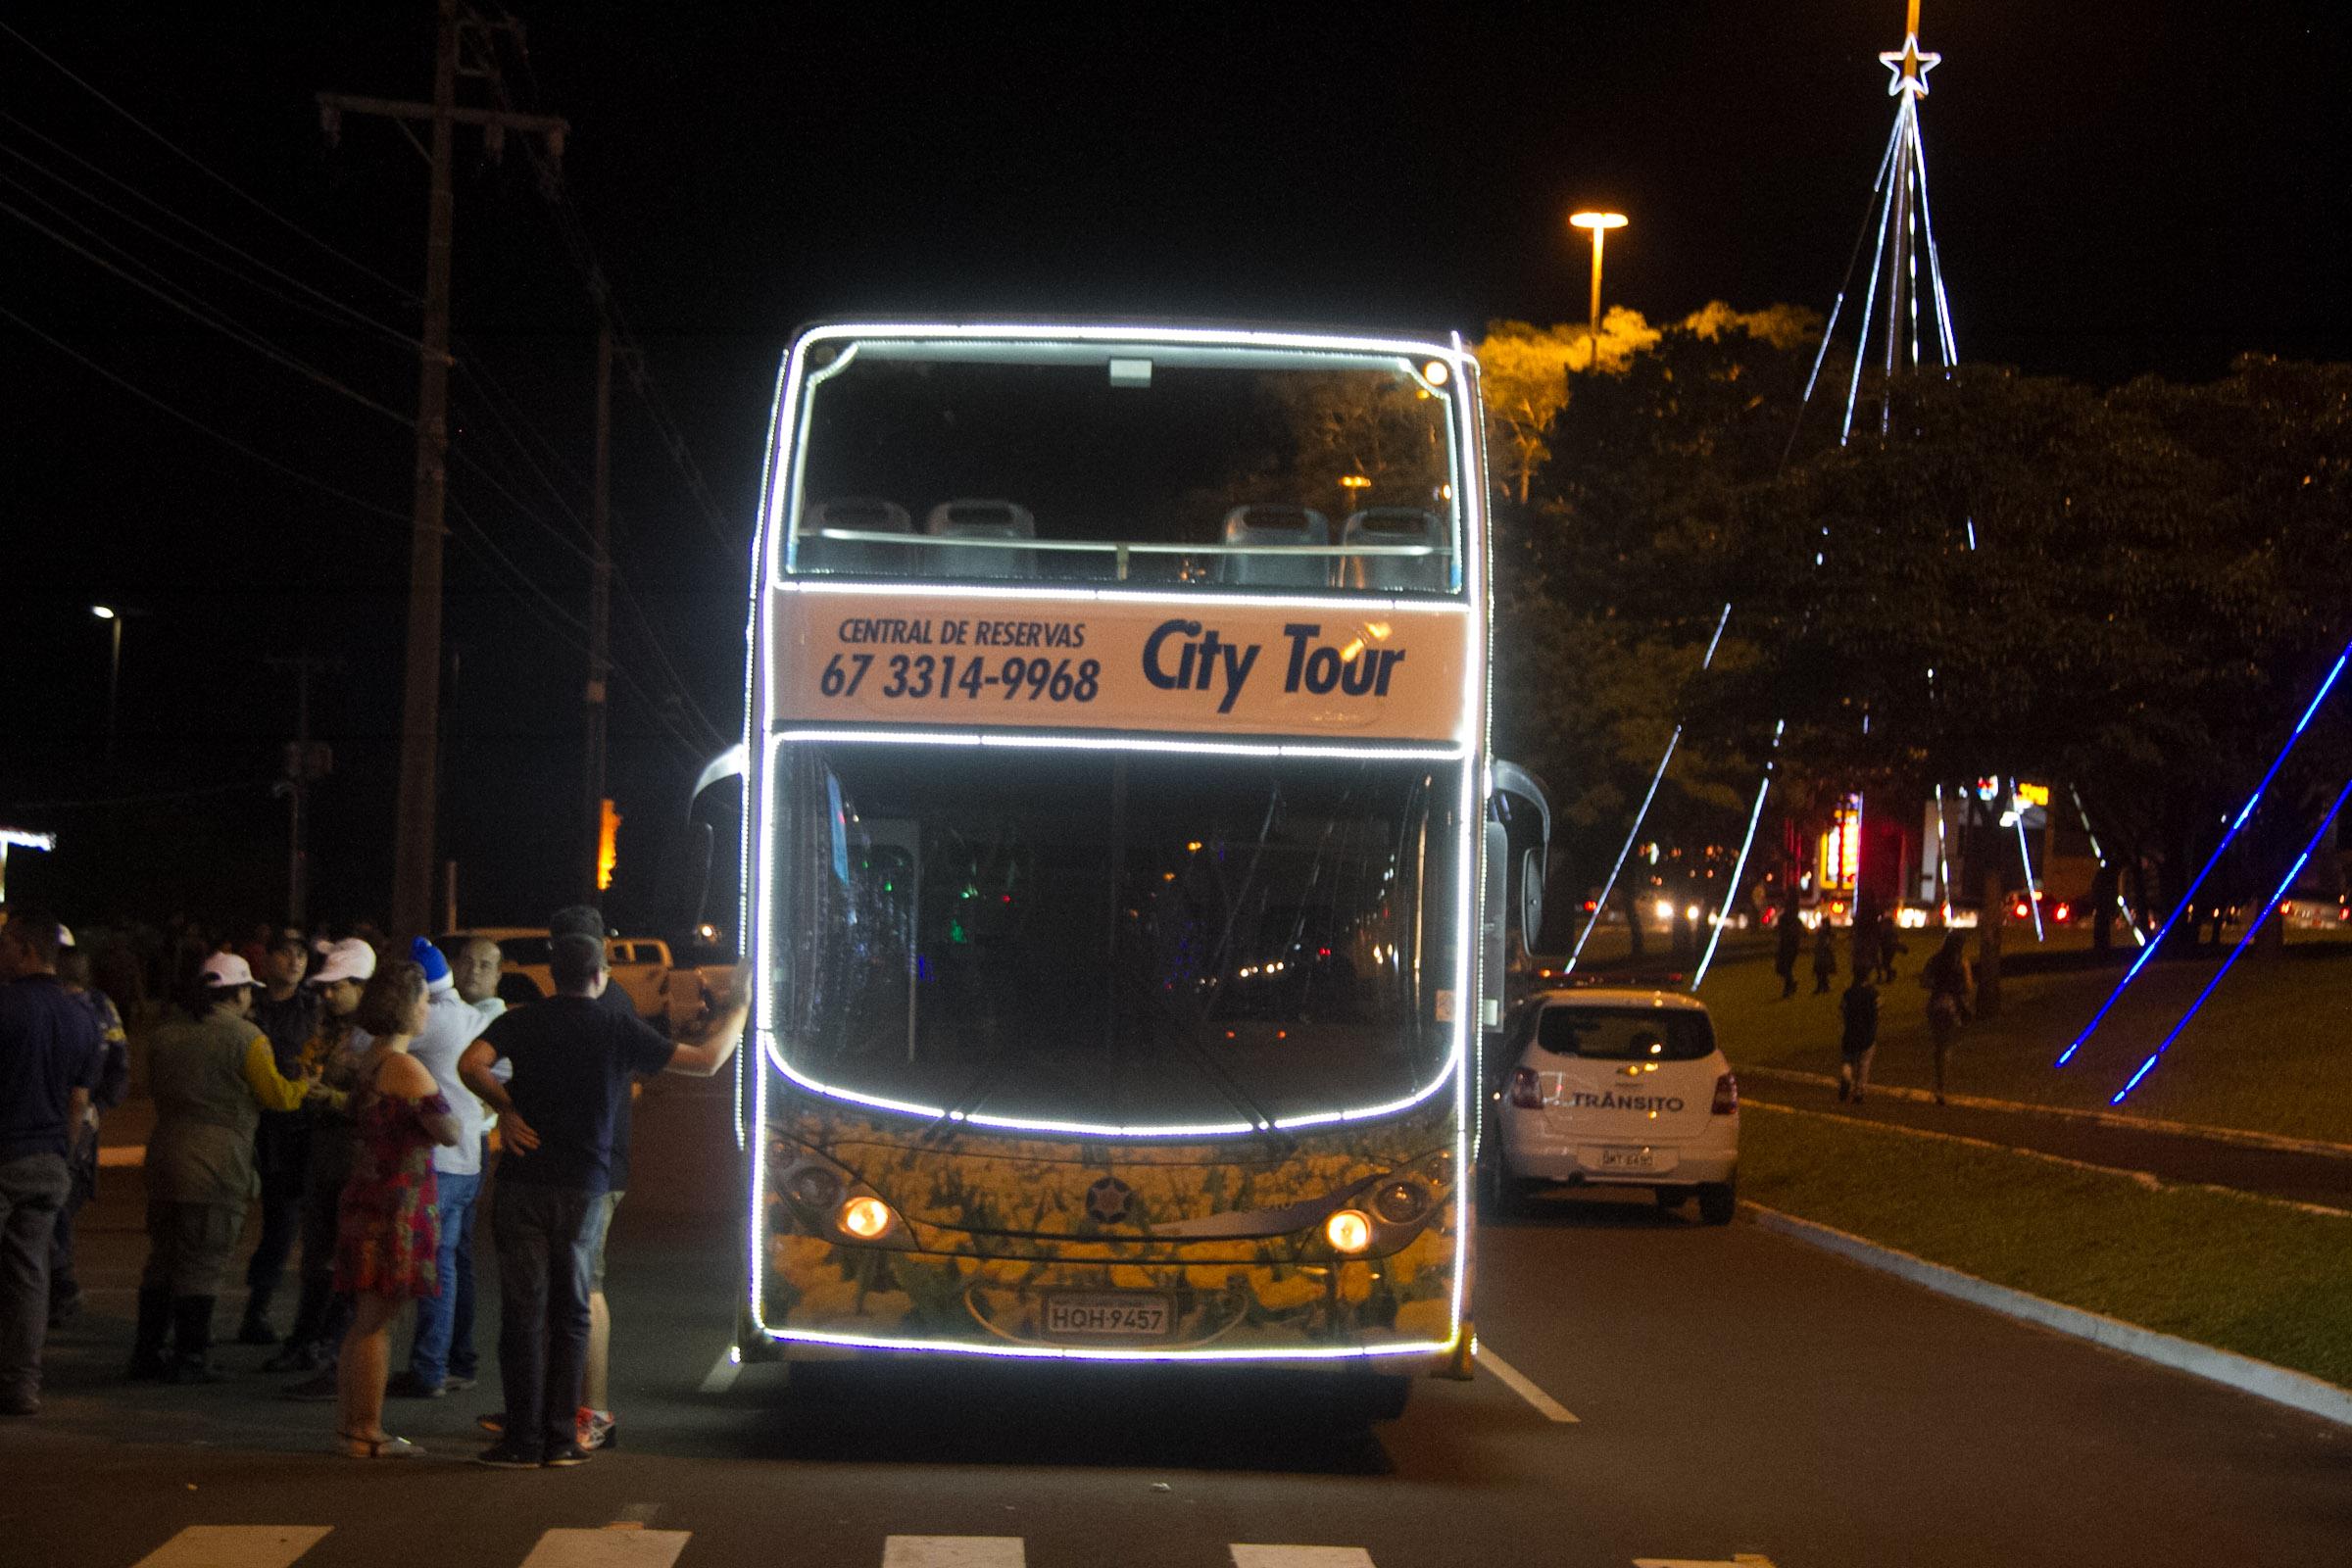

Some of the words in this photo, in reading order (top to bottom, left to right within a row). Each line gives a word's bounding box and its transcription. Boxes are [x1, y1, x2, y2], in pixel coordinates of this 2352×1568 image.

[839, 618, 933, 645] CENTRAL
[941, 620, 969, 646] DE
[975, 621, 1086, 648] RESERVAS
[820, 654, 874, 697] 67
[884, 655, 1101, 702] 3314-9968
[1143, 618, 1261, 713] City
[1284, 623, 1406, 697] Tour
